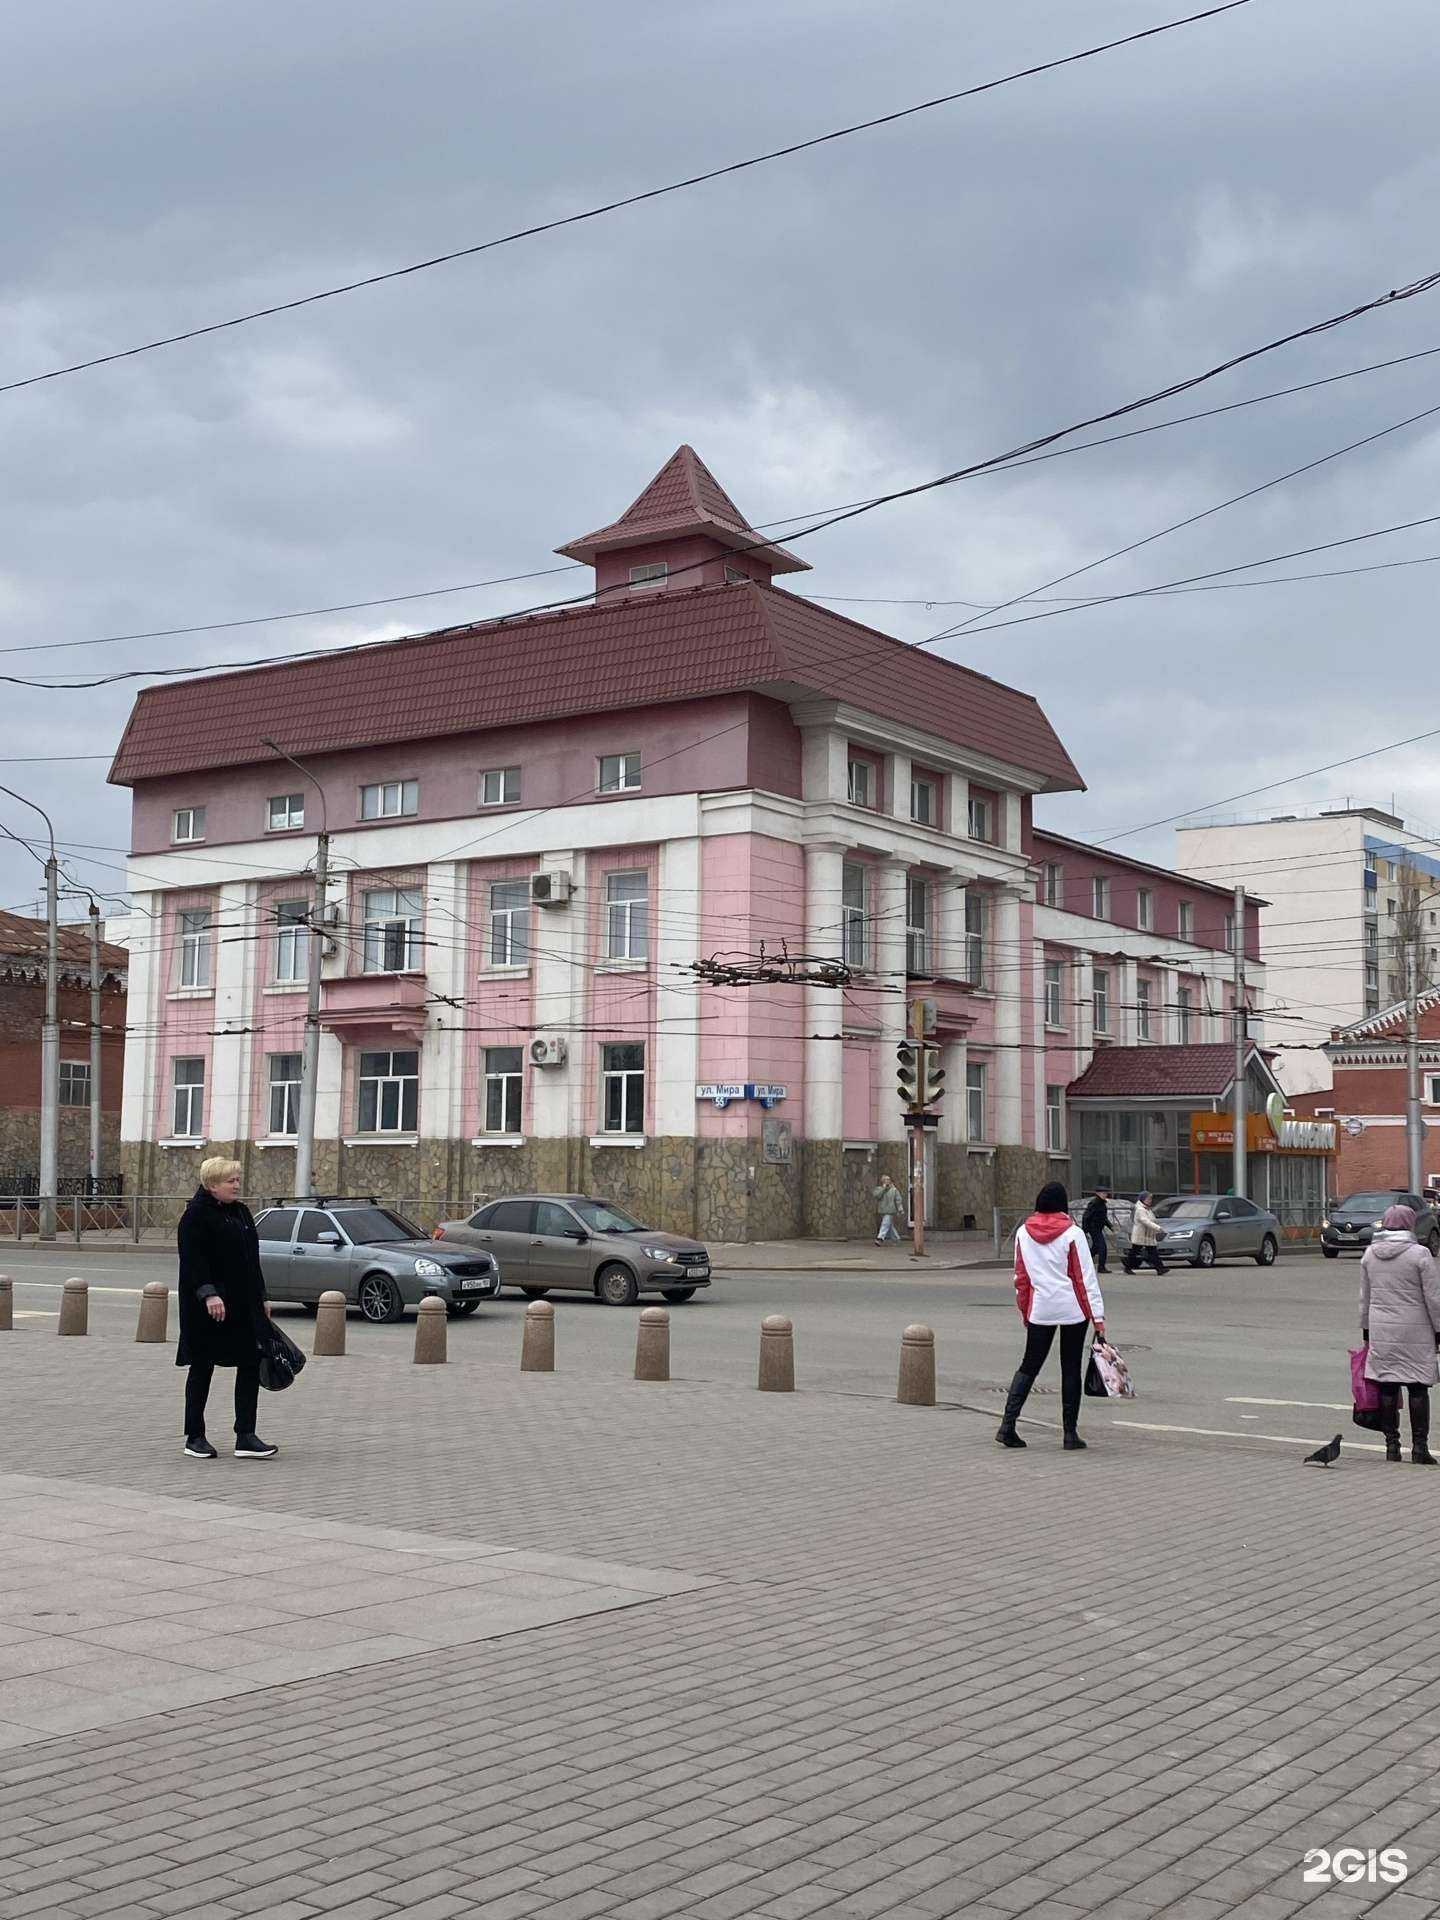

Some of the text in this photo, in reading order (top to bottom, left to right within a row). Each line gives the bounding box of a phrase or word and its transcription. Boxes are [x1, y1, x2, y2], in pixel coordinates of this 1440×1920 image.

[701, 1085, 740, 1096] ул. Мира
[768, 1085, 784, 1096] Мира
